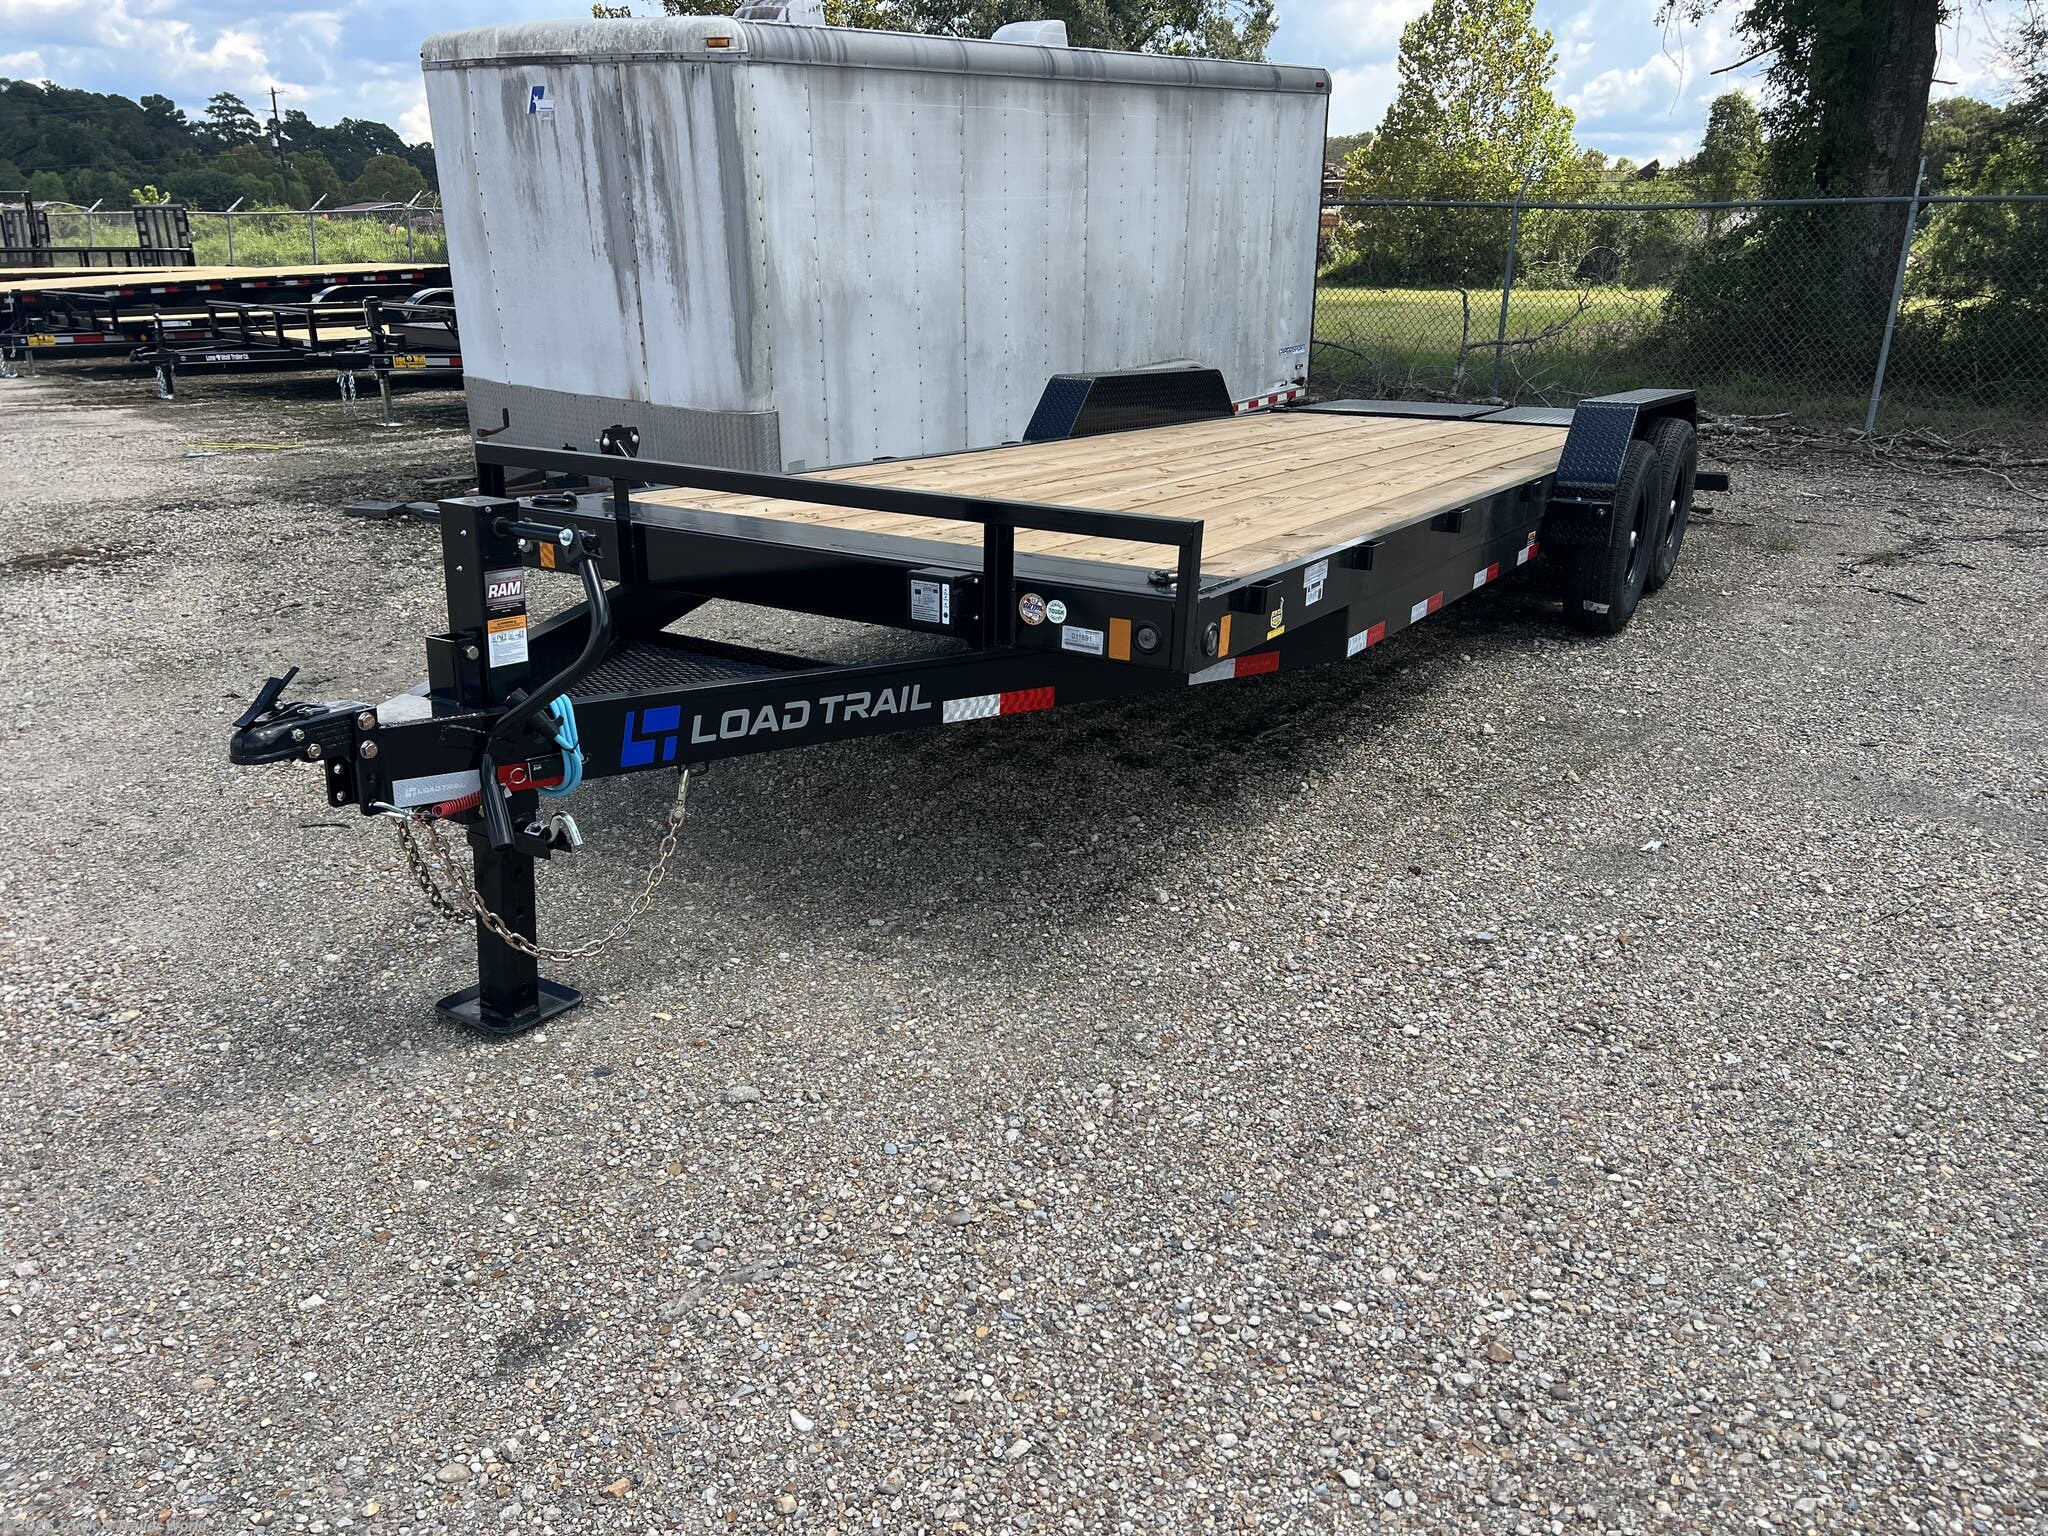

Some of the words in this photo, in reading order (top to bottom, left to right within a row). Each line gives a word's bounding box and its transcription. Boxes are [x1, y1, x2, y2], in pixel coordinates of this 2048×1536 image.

[488, 580, 521, 599] RAM
[691, 700, 810, 744] LOAD
[819, 684, 932, 724] TRAIL
